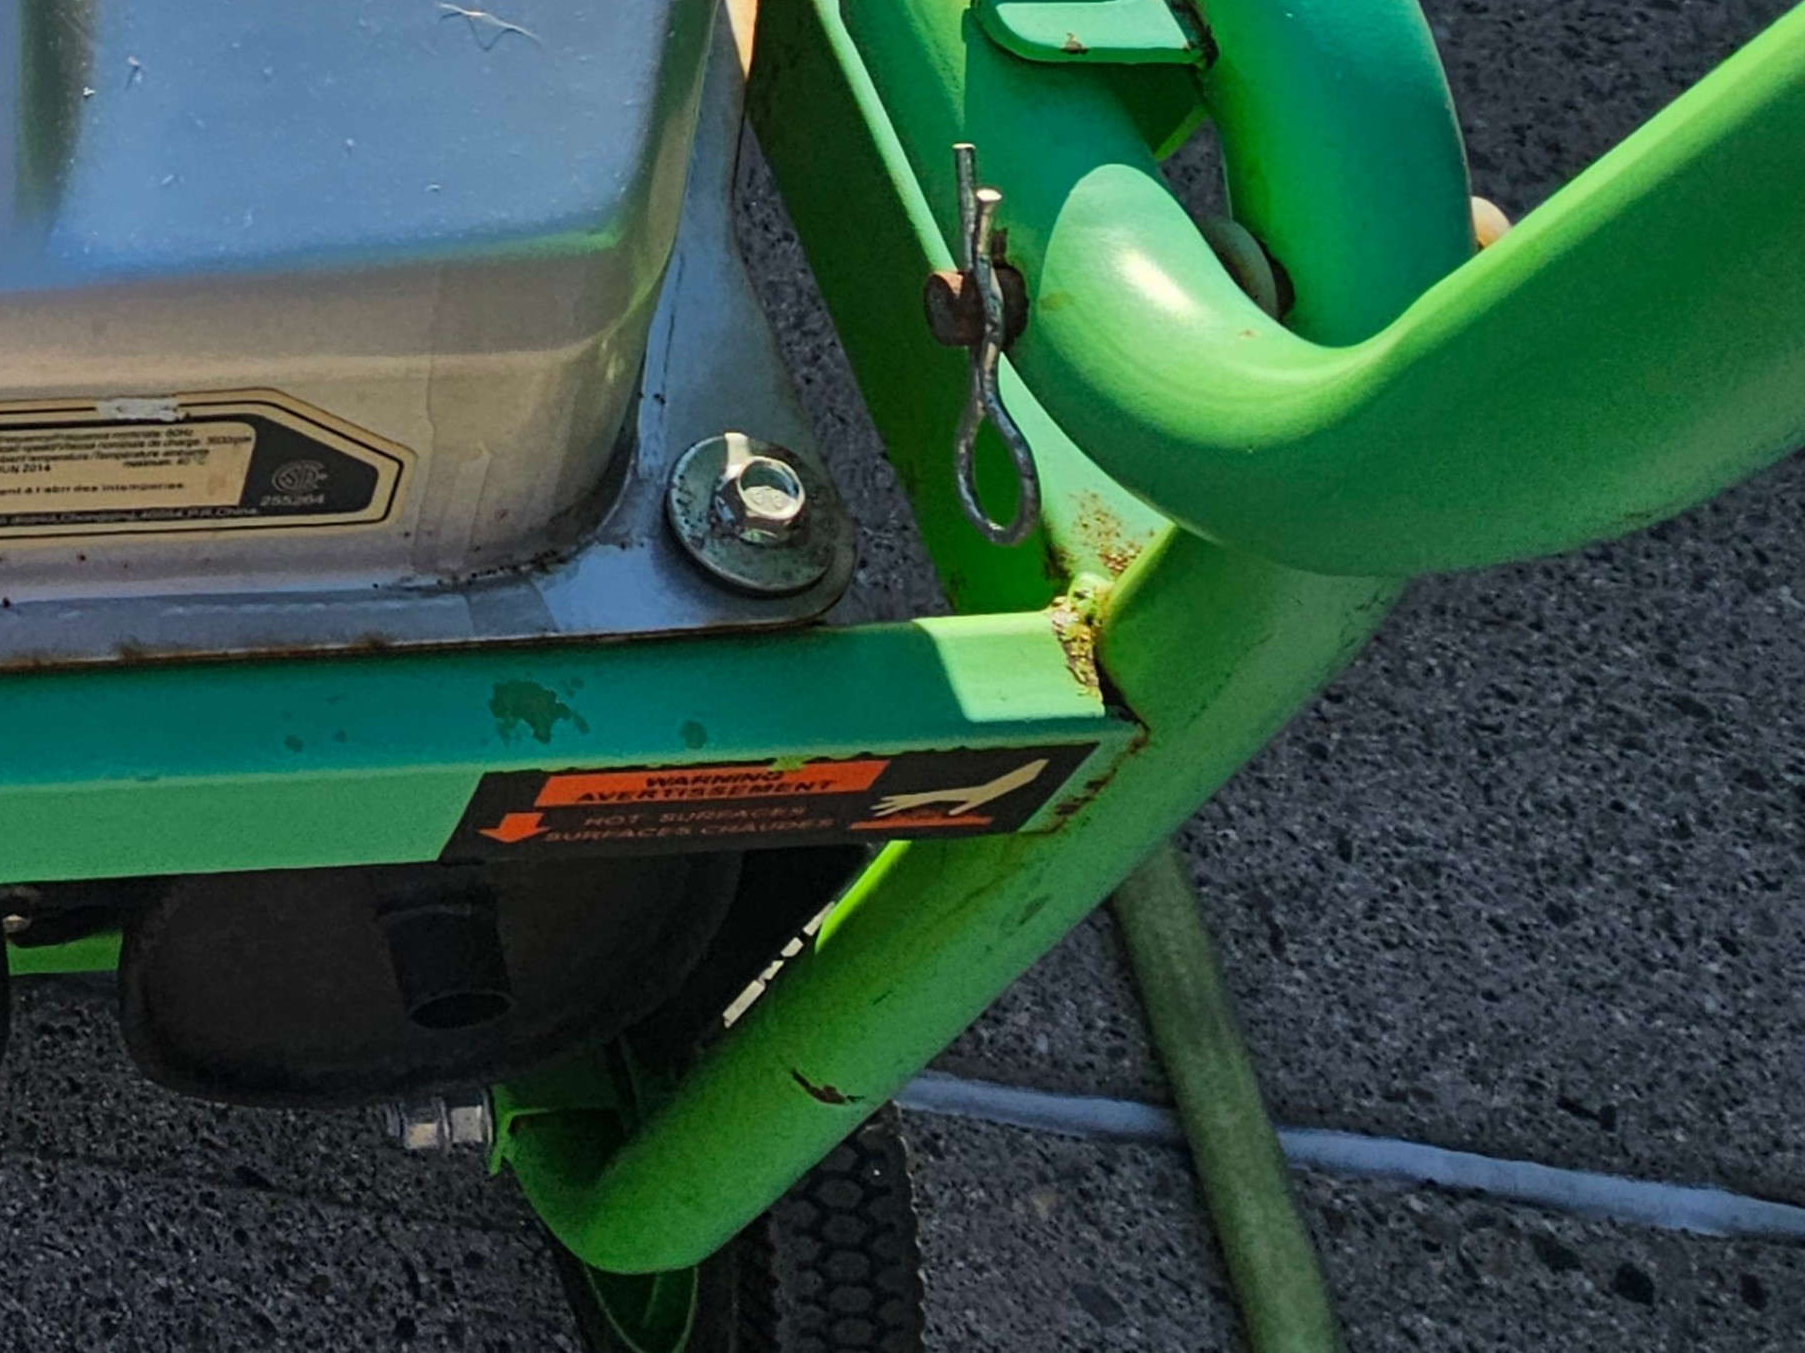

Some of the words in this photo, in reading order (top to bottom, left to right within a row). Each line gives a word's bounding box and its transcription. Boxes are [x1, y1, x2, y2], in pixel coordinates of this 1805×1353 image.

[646, 771, 784, 787] WARNING
[576, 780, 834, 801] AVERTISSEMENT
[585, 813, 640, 826] HOT
[659, 806, 807, 823] SURFACES
[545, 826, 691, 842] SURFACES
[701, 818, 834, 834] CHAUDES
